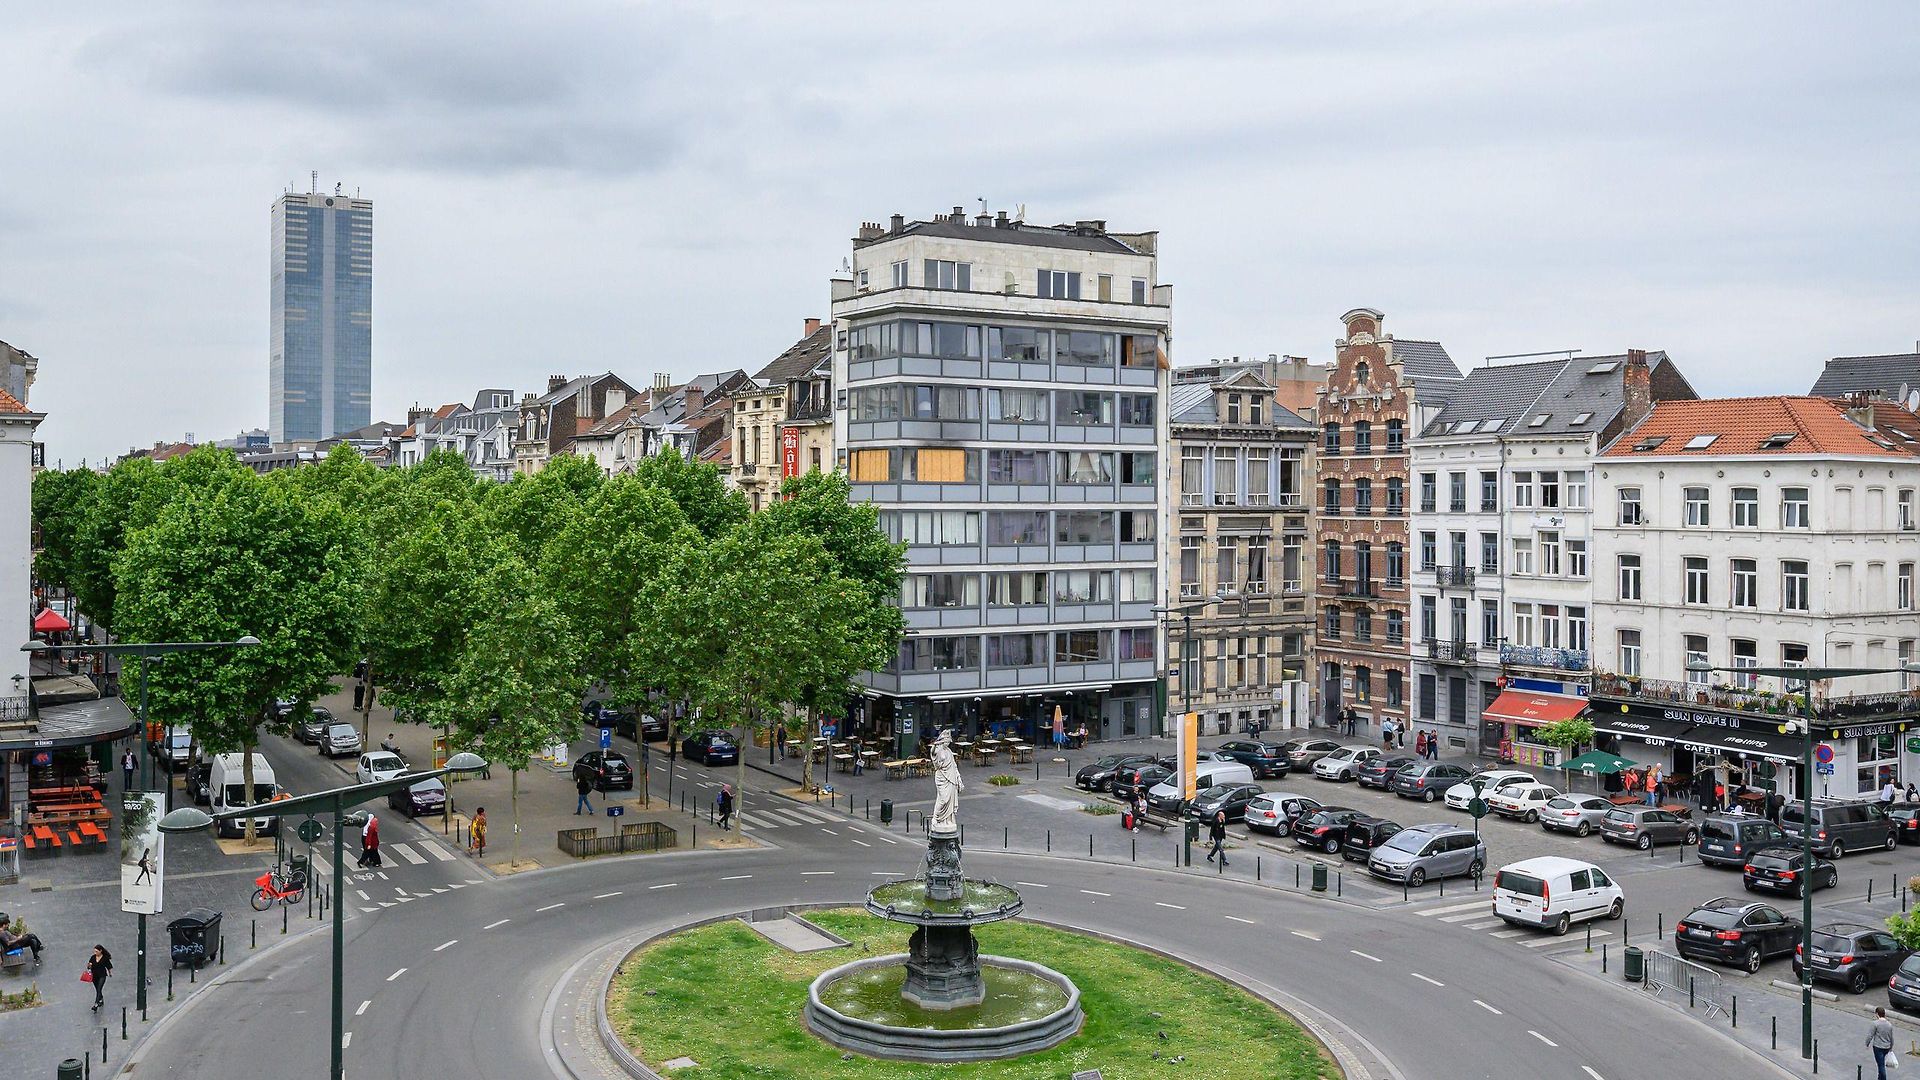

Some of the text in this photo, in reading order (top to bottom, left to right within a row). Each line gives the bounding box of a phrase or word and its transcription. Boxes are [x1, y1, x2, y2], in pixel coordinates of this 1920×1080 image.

[1664, 710, 1740, 728] SUN CAFE II
[601, 729, 609, 741] P
[1844, 728, 1862, 738] SUN
[1864, 725, 1886, 736] CAFE
[1645, 737, 1666, 747] SUN
